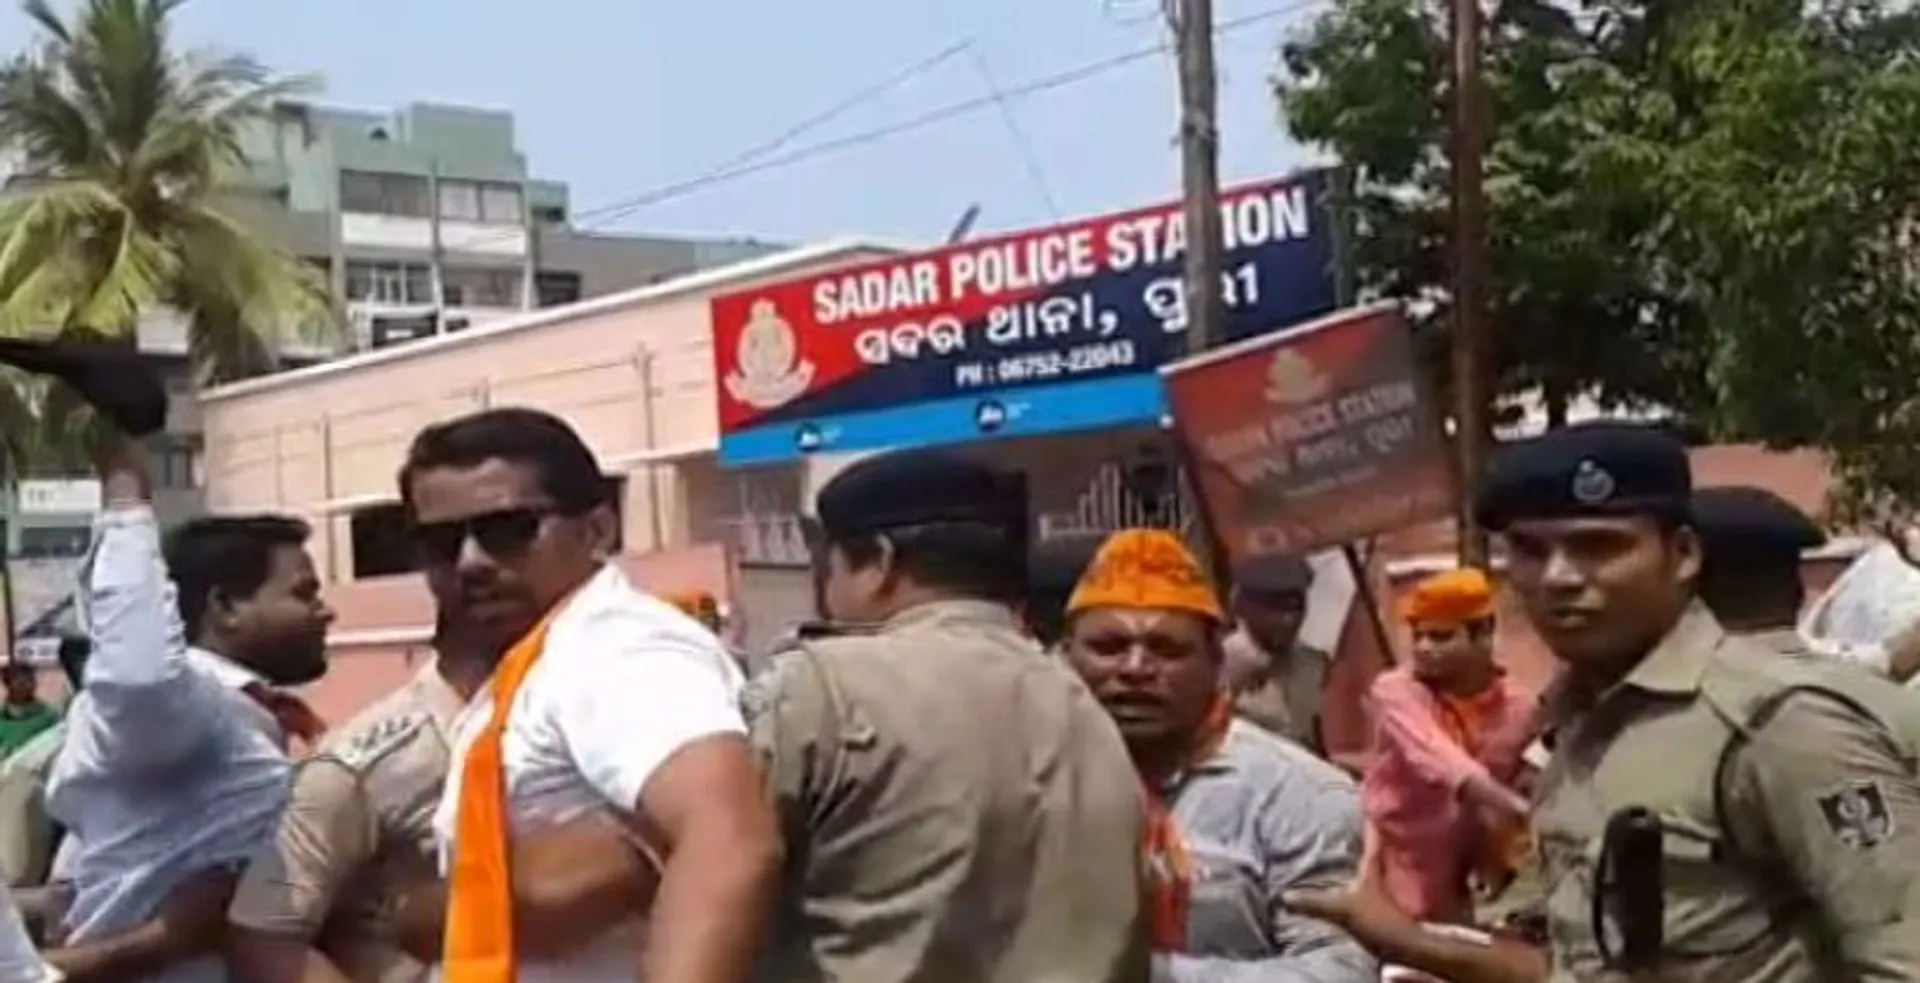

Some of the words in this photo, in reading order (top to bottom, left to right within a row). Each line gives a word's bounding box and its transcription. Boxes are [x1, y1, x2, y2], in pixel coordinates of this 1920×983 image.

[813, 260, 940, 324] SADAR
[950, 229, 1097, 299] POLICE
[1106, 186, 1308, 271] STAION
[854, 315, 965, 364] ସଦର
